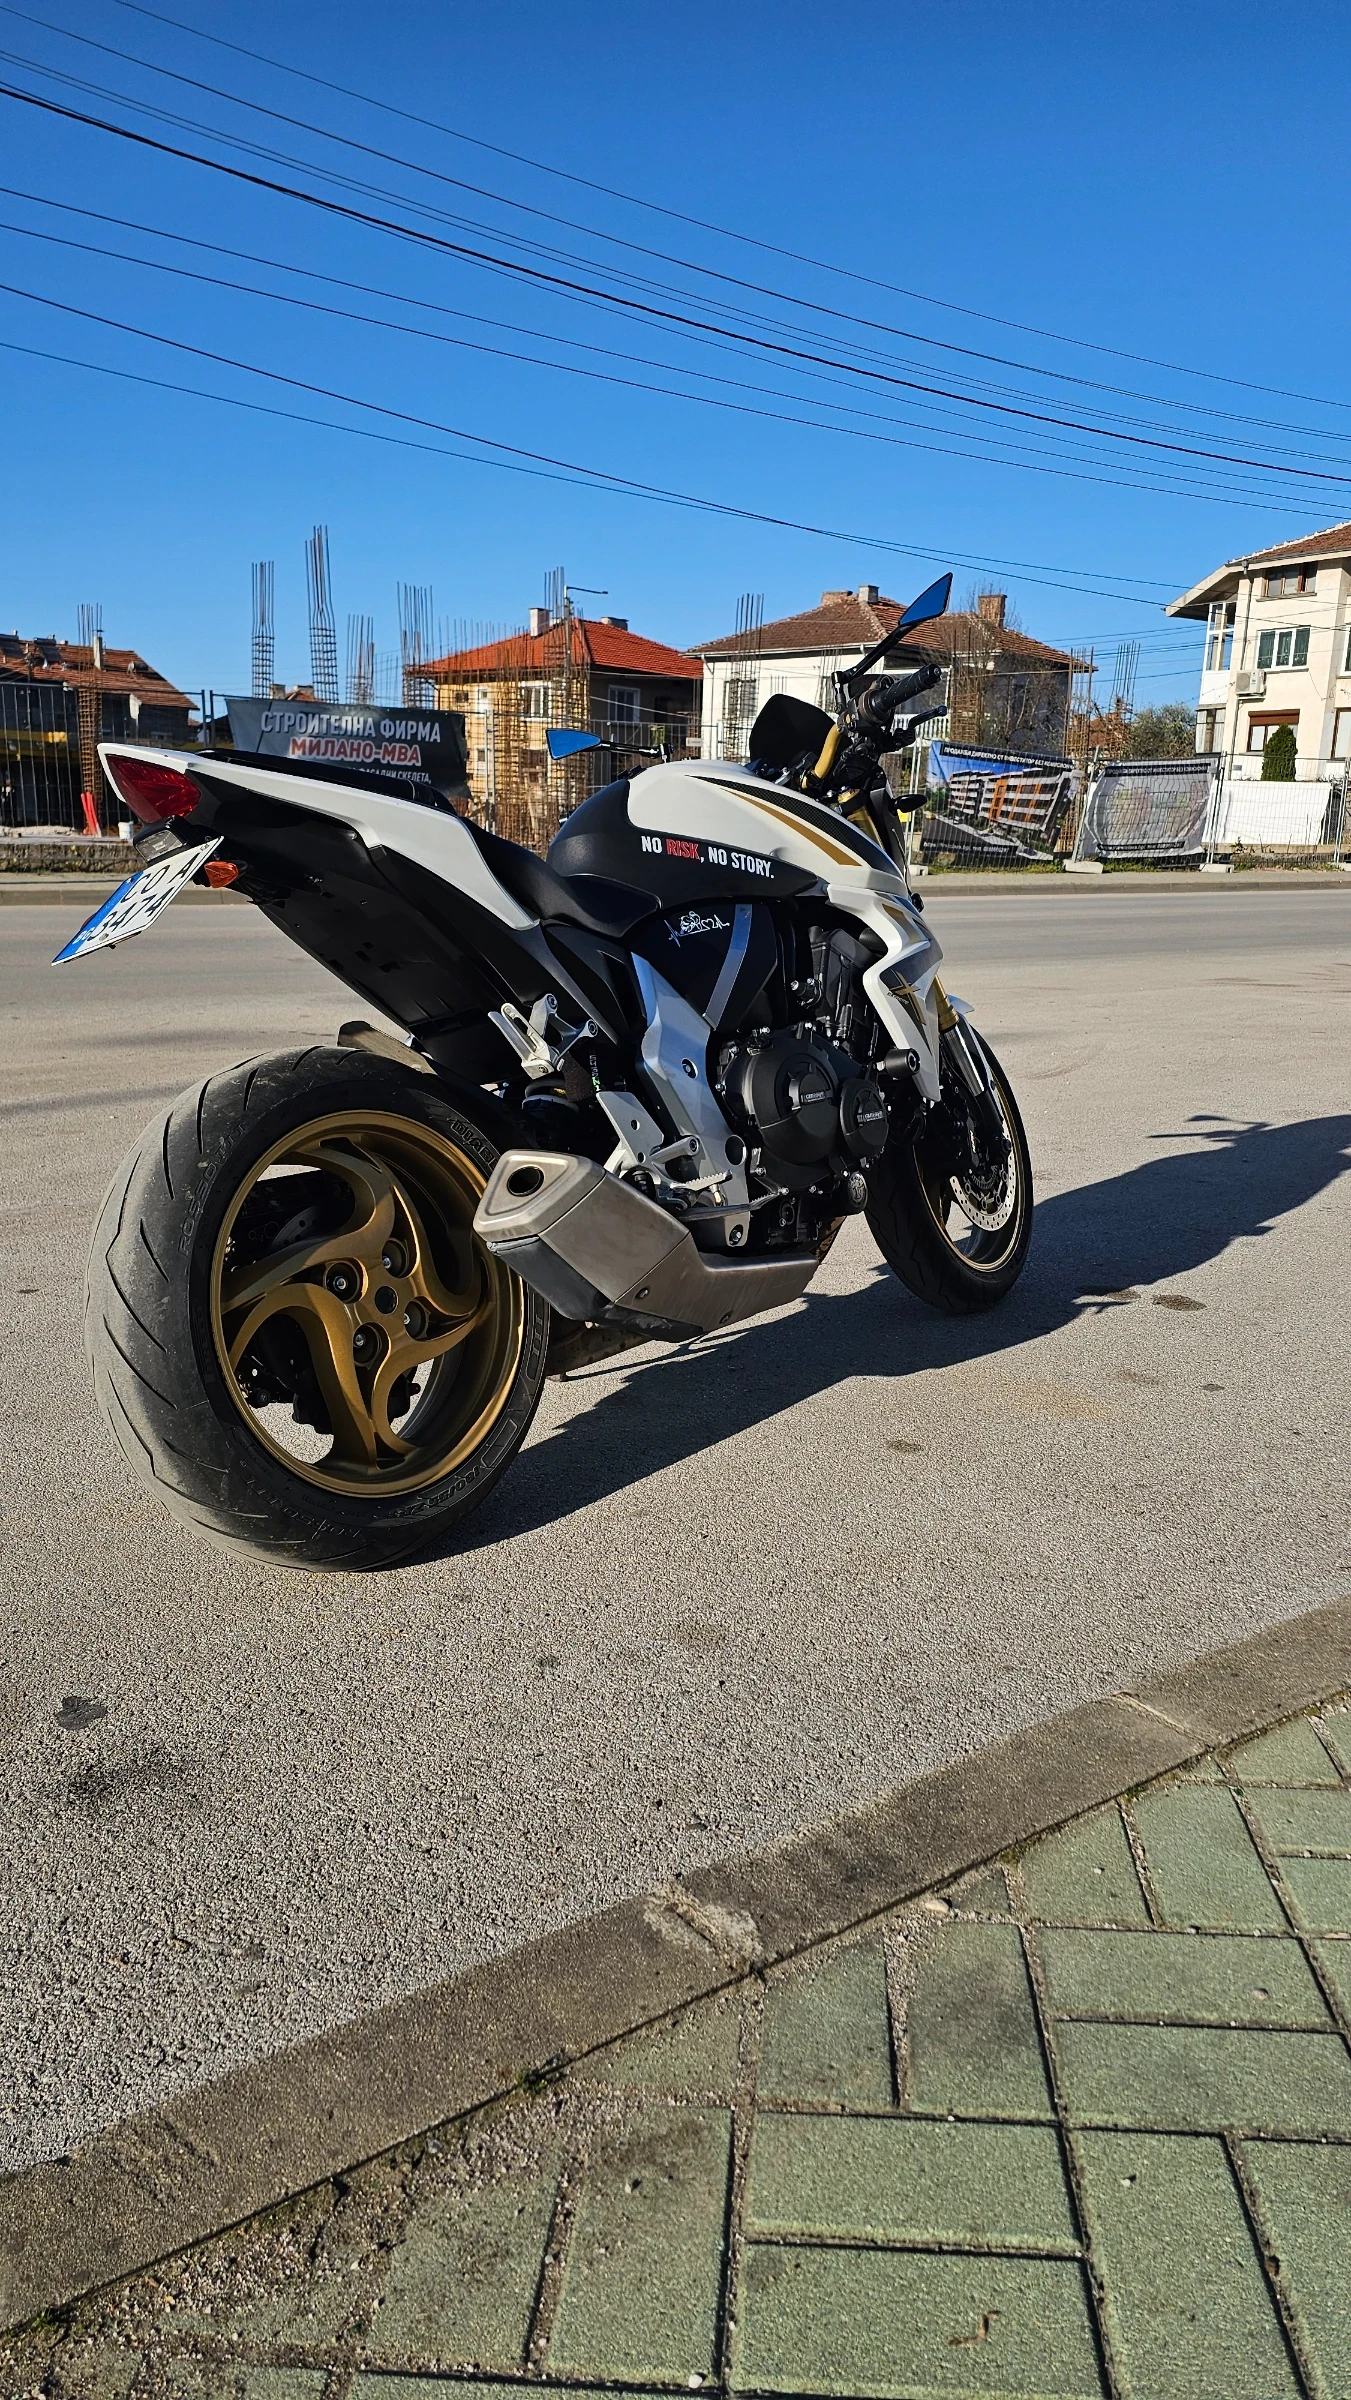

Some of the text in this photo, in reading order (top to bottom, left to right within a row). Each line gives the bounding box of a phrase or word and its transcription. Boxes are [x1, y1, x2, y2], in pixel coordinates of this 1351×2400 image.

[260, 711, 441, 743] СТРОИТЕЛНА ФИРМА
[290, 737, 422, 767] МИЛАНО-МВА
[120, 852, 201, 904] CO A
[641, 835, 775, 879] NO RISK, NO STORY.
[450, 1118, 501, 1172] DIABL
[177, 1161, 218, 1257] ROSSO
